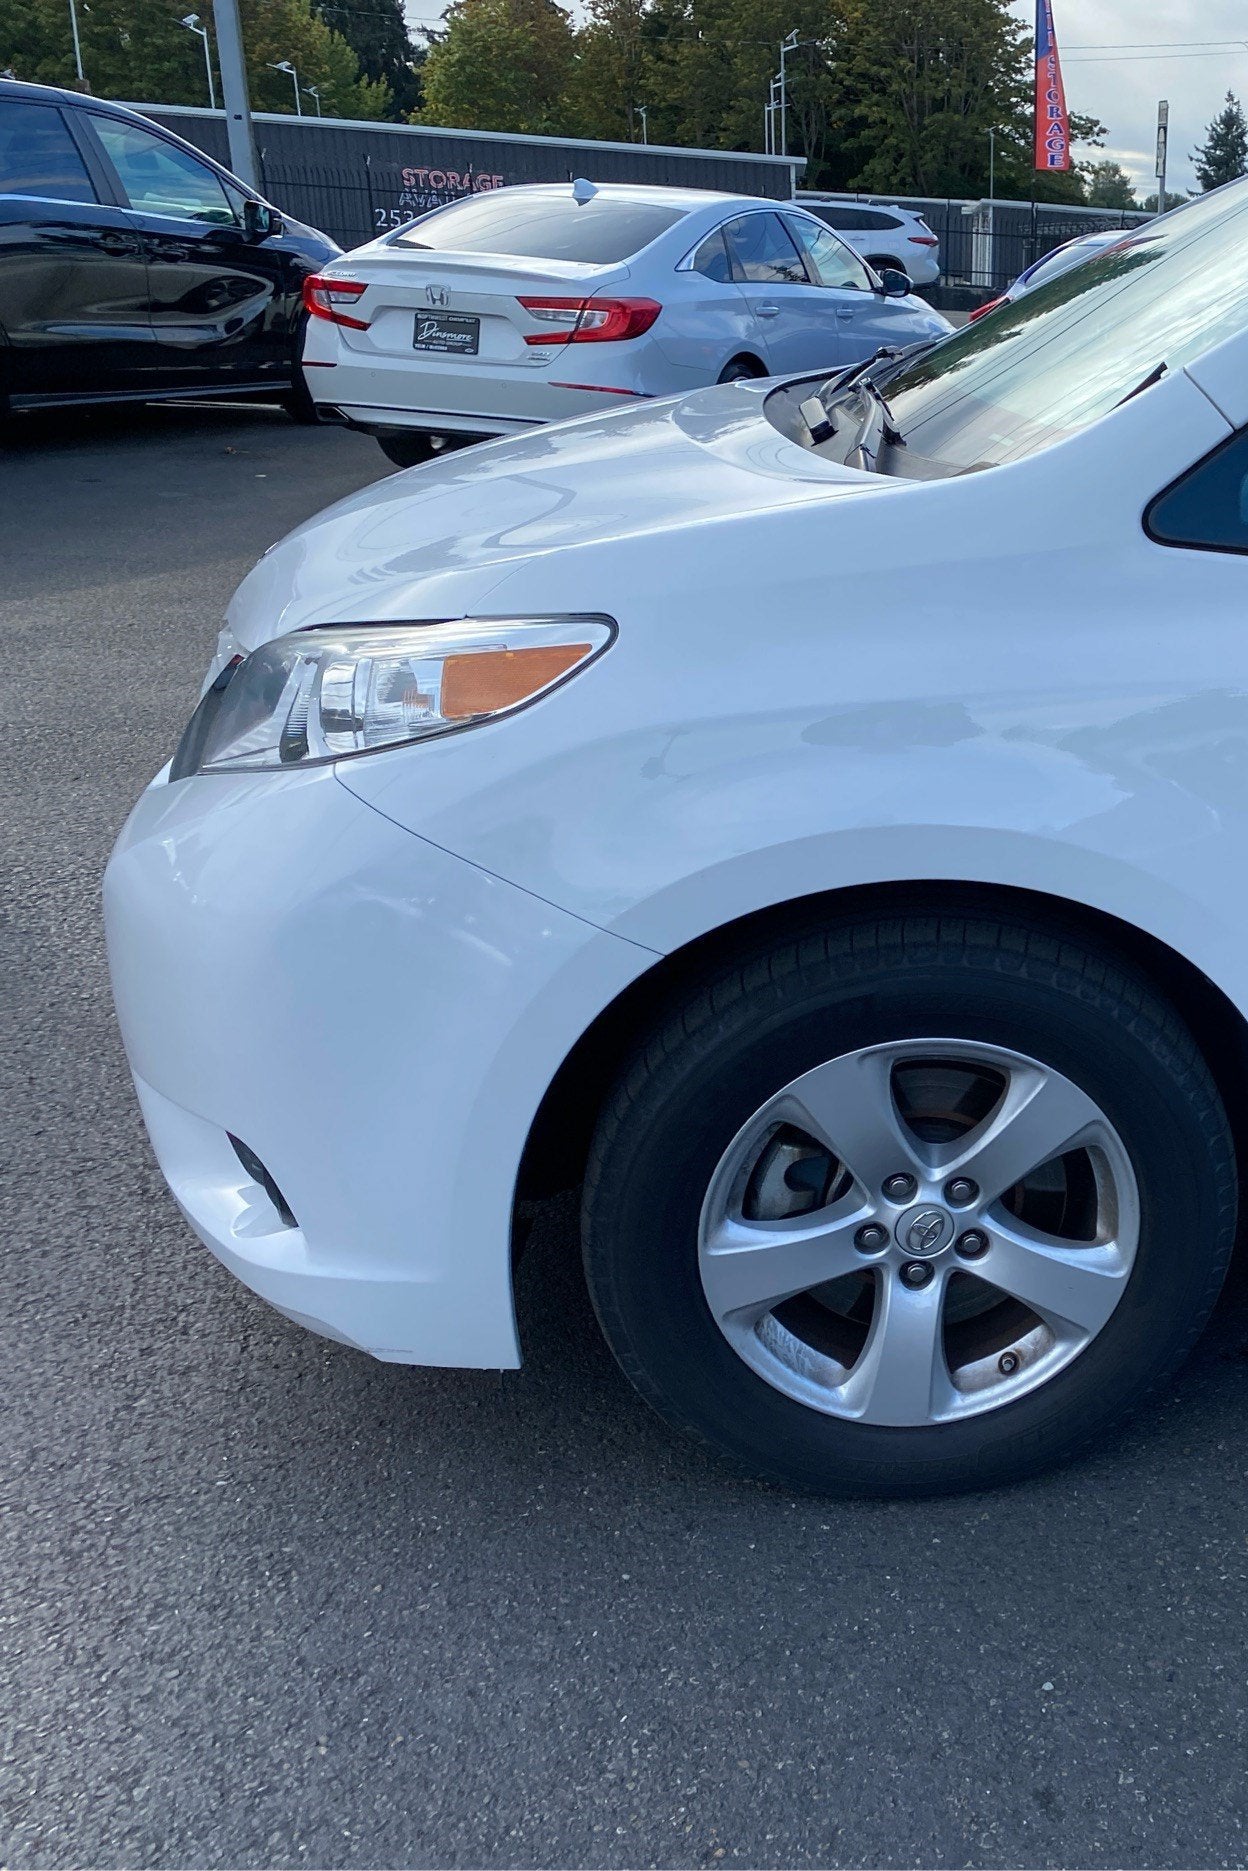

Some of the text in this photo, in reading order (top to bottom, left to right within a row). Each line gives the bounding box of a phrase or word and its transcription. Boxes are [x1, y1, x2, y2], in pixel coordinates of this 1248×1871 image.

[1046, 55, 1066, 167] STORAGE
[401, 168, 504, 191] STORAGE
[417, 321, 474, 341] Dinsmore
